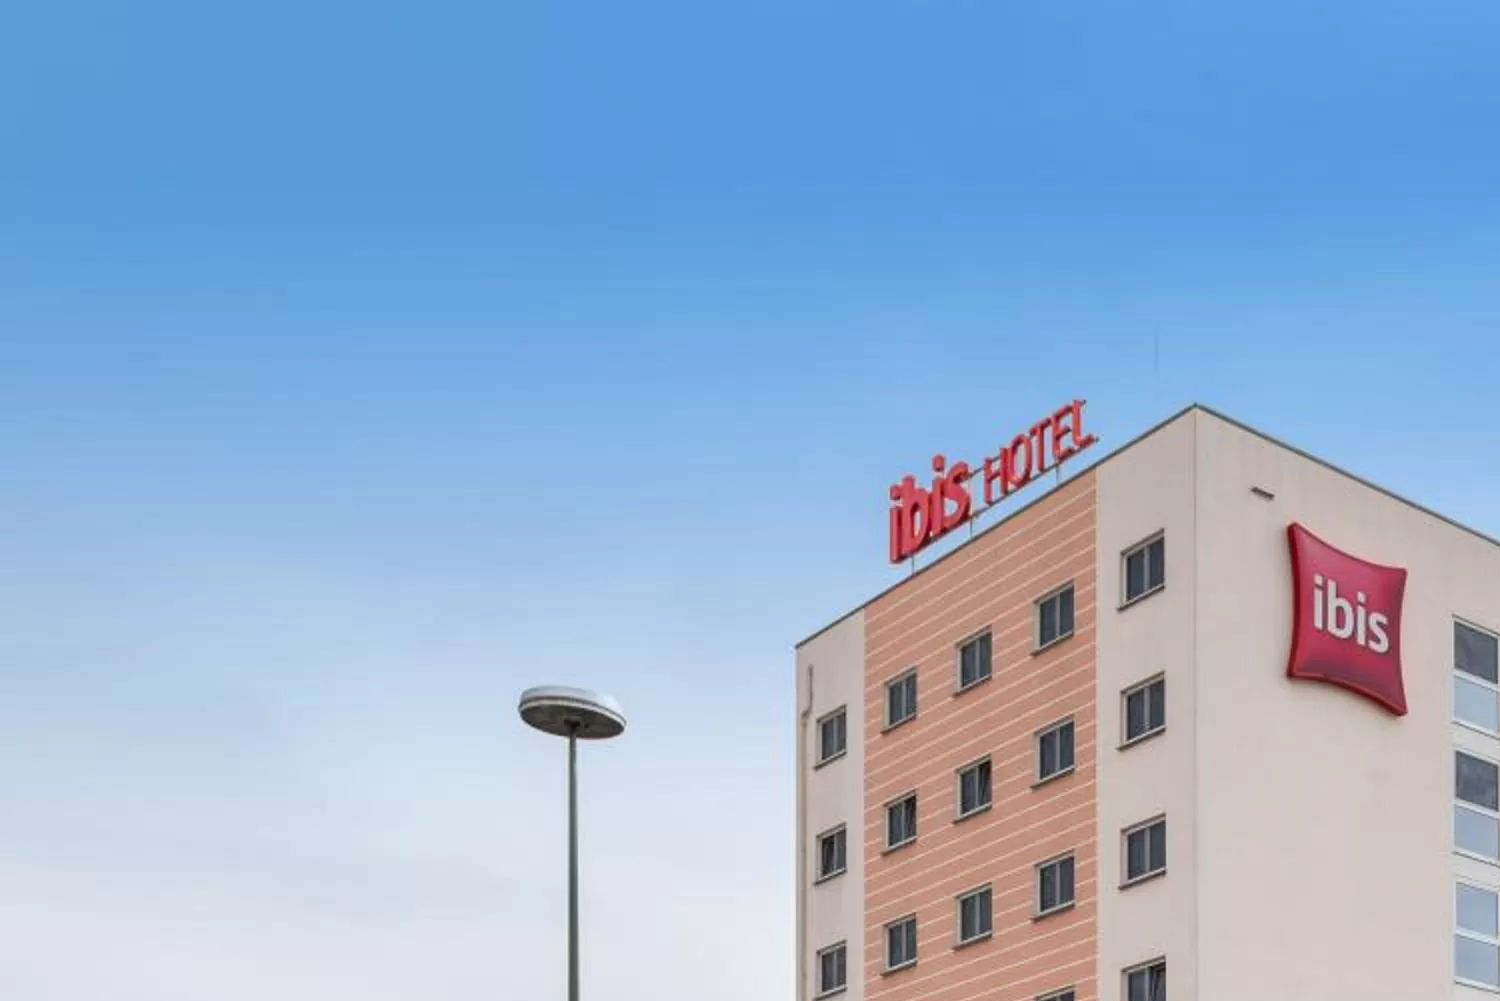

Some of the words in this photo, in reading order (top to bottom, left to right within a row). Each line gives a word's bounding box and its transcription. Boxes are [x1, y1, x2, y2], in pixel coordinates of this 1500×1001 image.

[889, 454, 970, 564] ibis
[984, 399, 1097, 505] HOTEL
[1313, 573, 1388, 653] ibis
